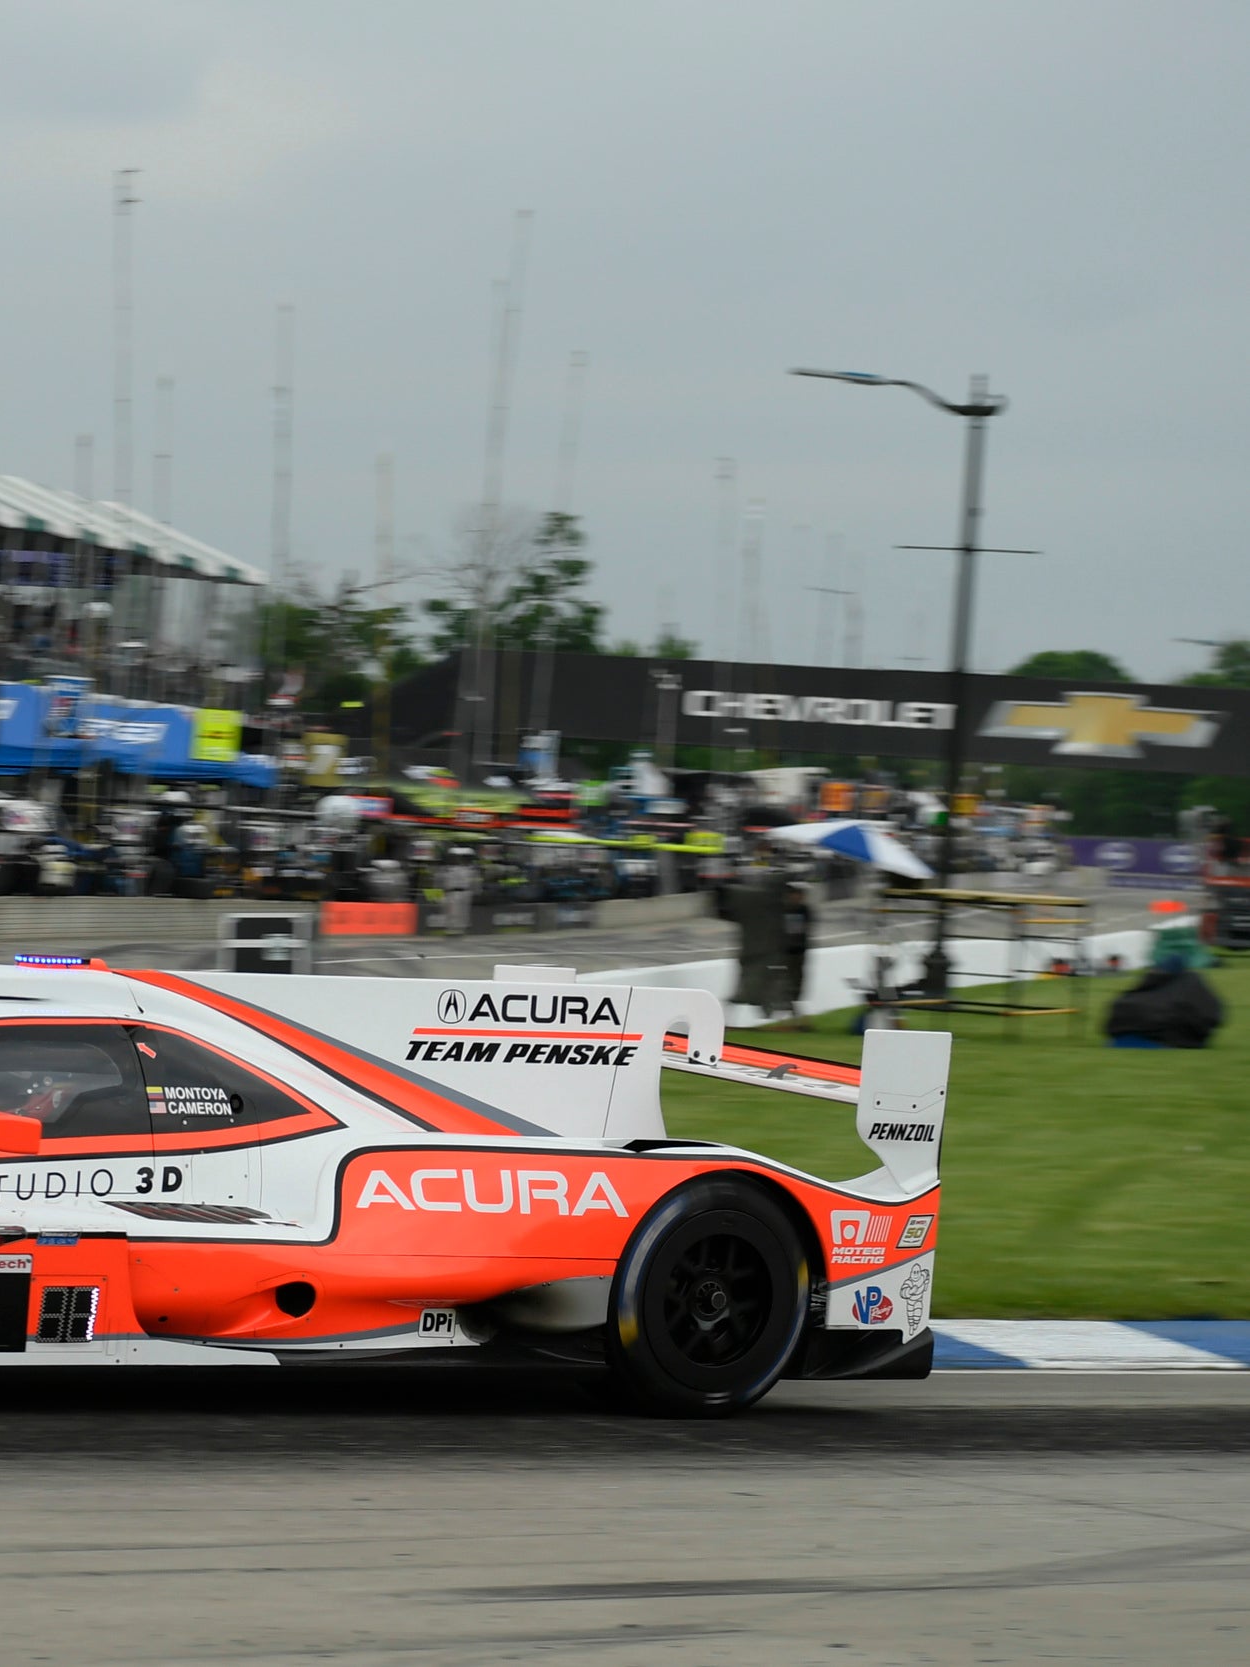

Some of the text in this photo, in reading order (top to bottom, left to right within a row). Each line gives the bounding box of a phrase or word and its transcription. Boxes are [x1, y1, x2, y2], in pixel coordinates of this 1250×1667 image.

[468, 993, 621, 1026] ACURA
[405, 1040, 638, 1066] TEAM PENSKE
[164, 1086, 228, 1100] MONTOYA
[168, 1101, 232, 1115] CAMERON
[868, 1123, 935, 1142] PENNZOIL
[356, 1169, 630, 1218] ACURA
[831, 1247, 886, 1255] MOTEGI
[831, 1256, 885, 1264] RACING
[854, 1286, 882, 1324] VP
[422, 1312, 454, 1332] DPi
